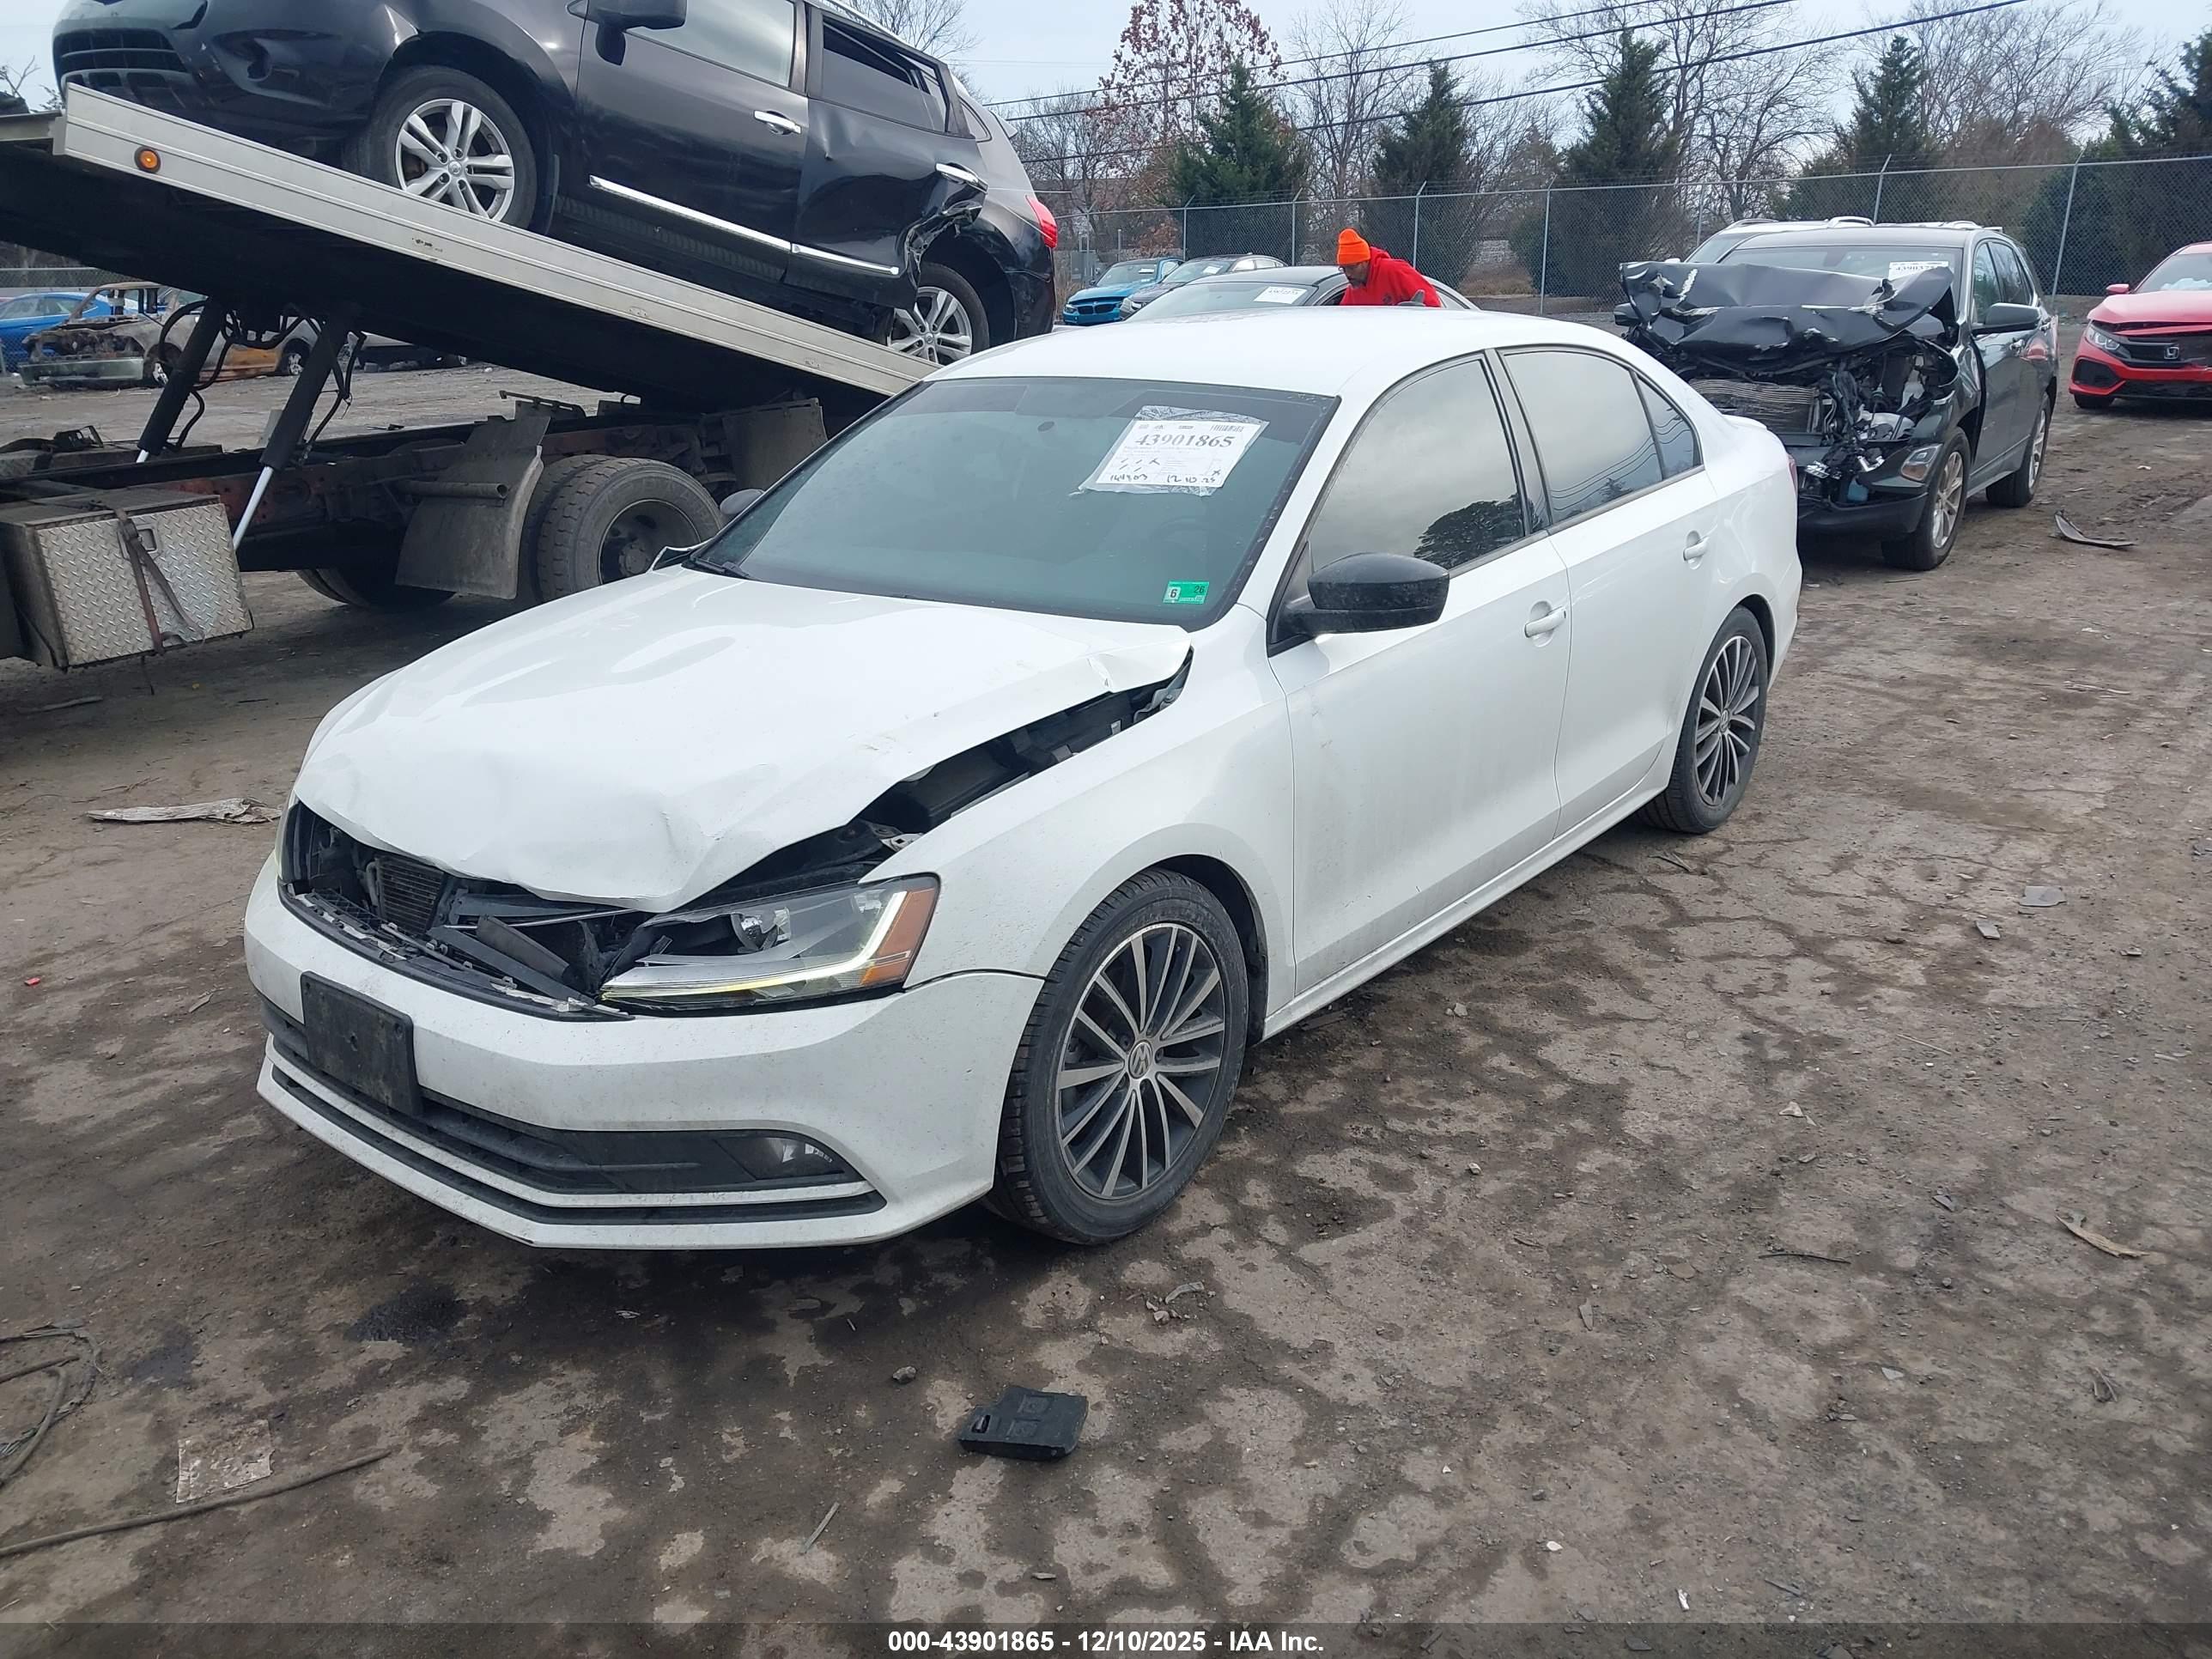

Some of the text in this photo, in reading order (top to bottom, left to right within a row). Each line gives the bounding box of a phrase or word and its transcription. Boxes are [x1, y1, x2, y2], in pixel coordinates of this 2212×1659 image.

[1135, 434, 1236, 448] 43901865
[1170, 588, 1178, 599] 6
[1194, 586, 1206, 594] 26
